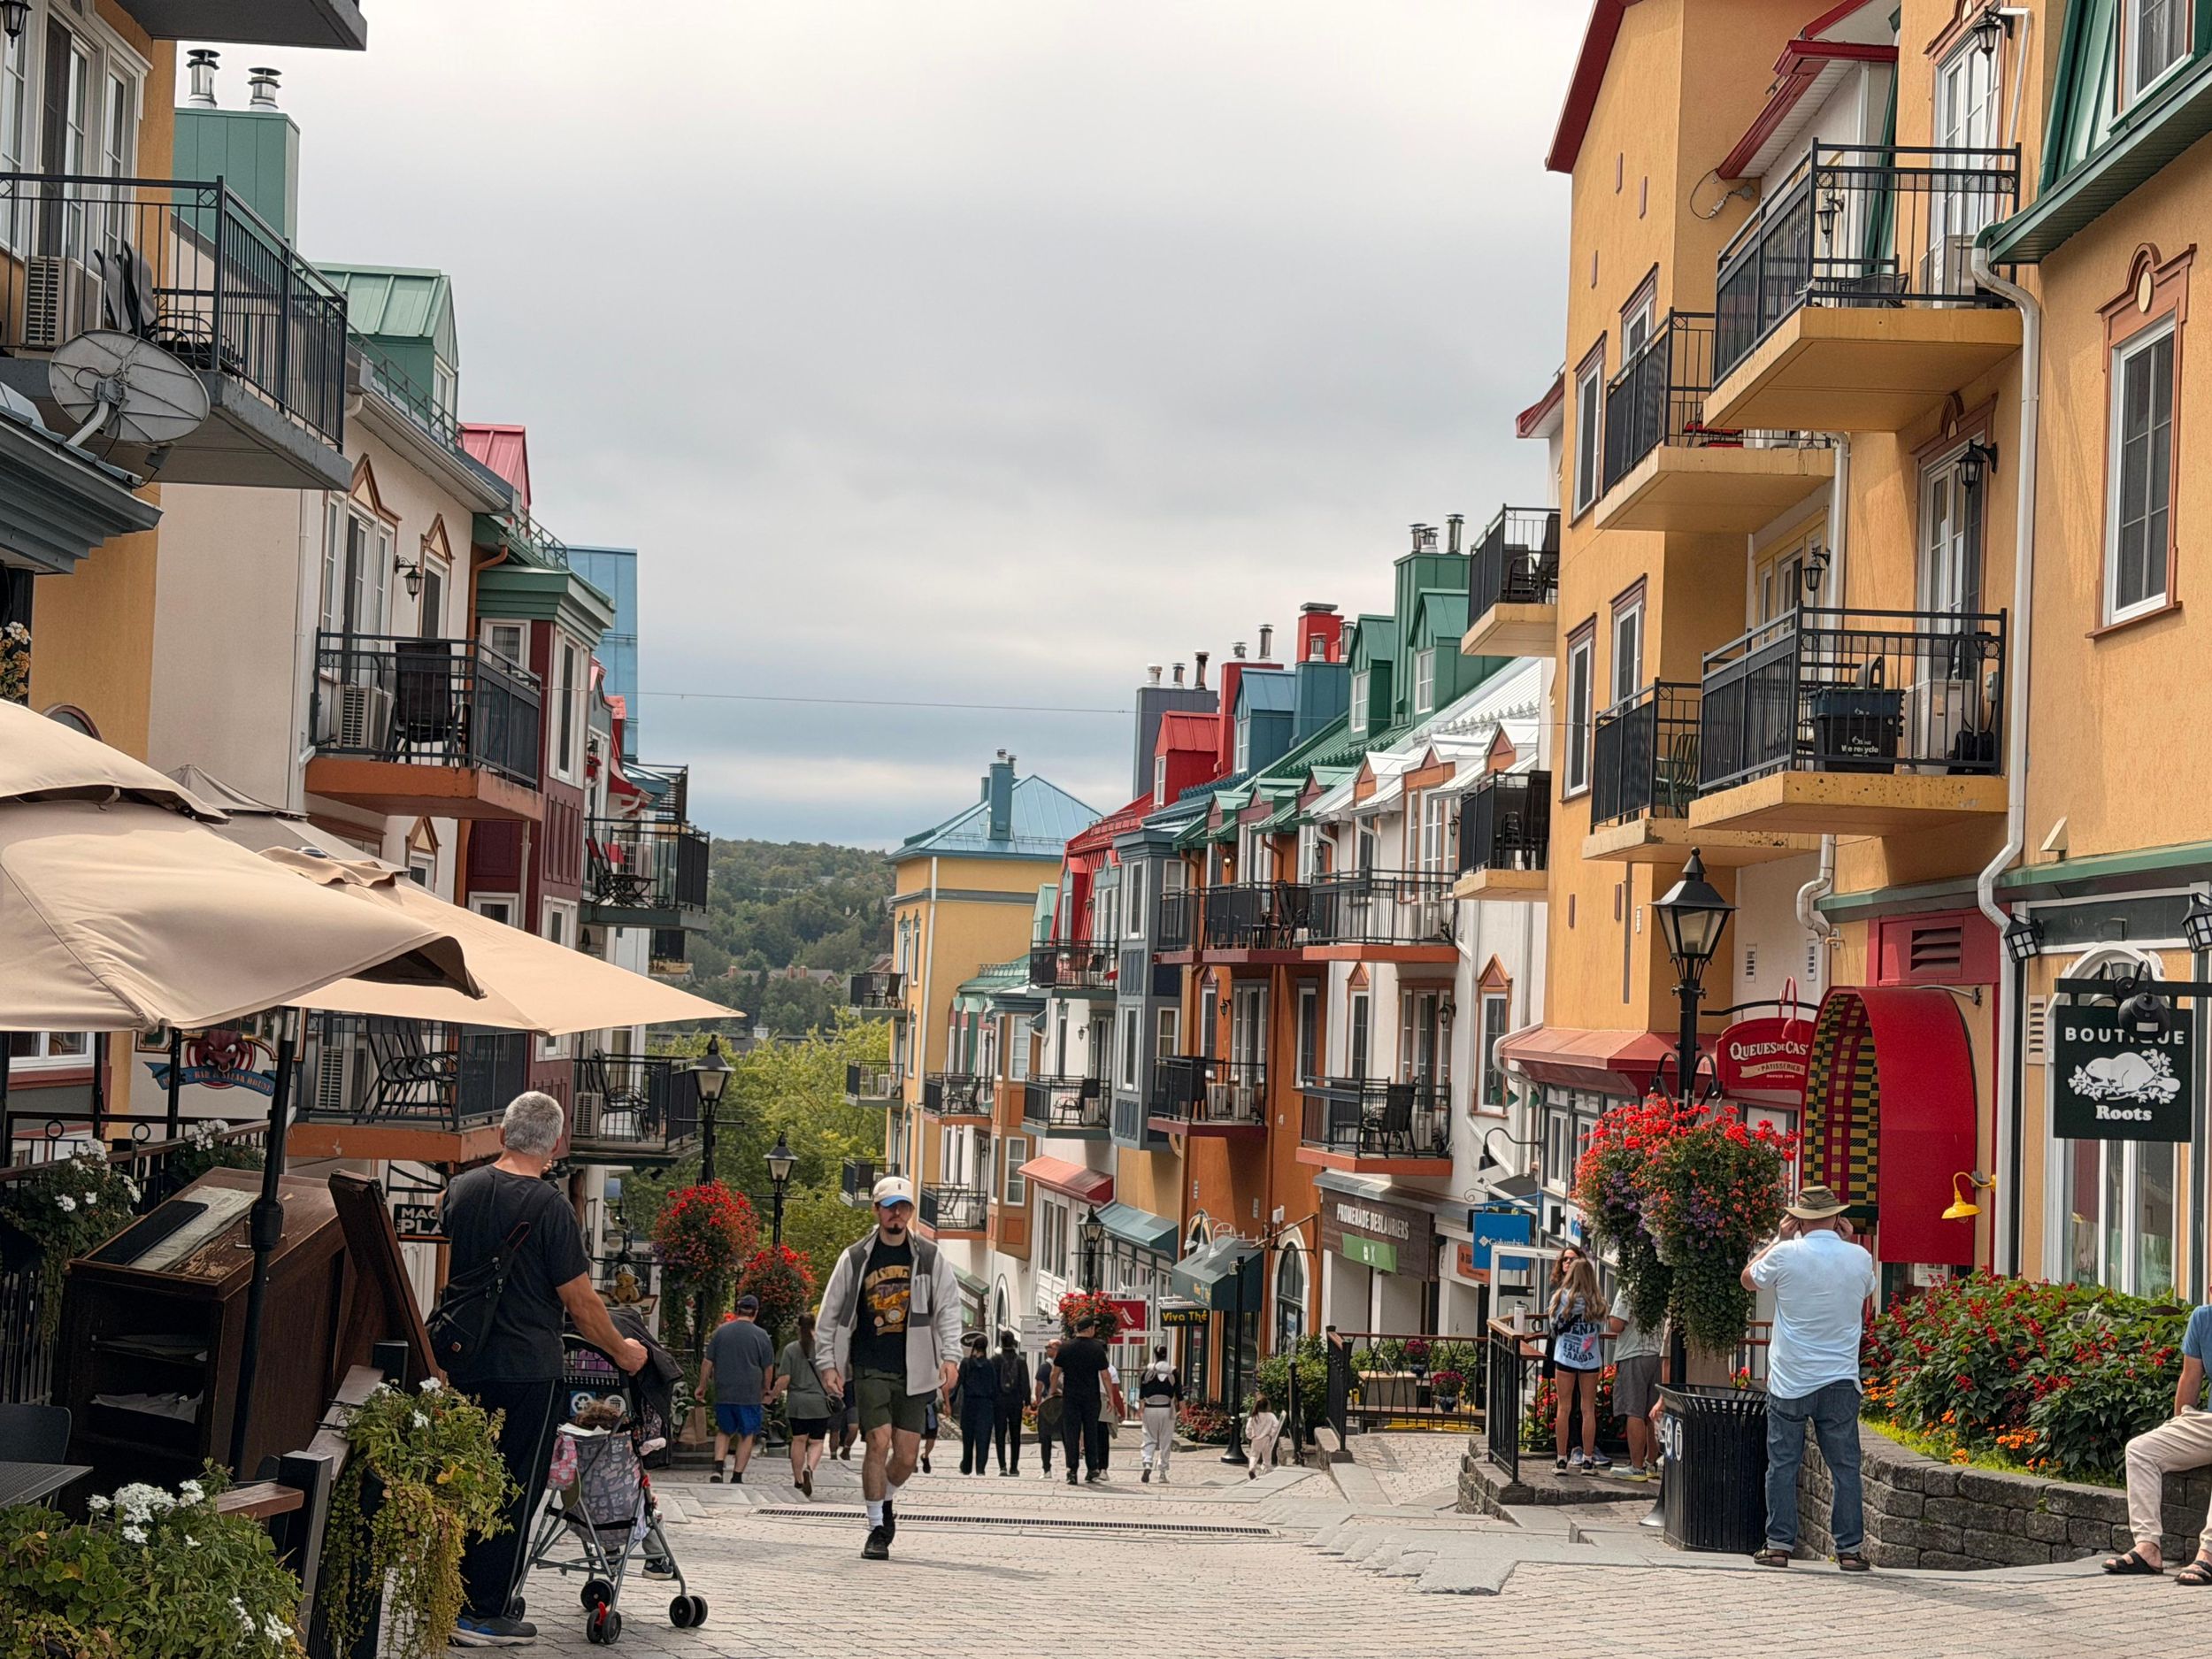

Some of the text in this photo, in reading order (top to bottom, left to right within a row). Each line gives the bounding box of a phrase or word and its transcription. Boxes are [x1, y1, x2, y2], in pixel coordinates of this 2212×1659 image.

[2065, 1026, 2185, 1045] BOUTIUE
[1786, 1041, 1809, 1056] CAS
[2095, 1105, 2153, 1121] Roots
